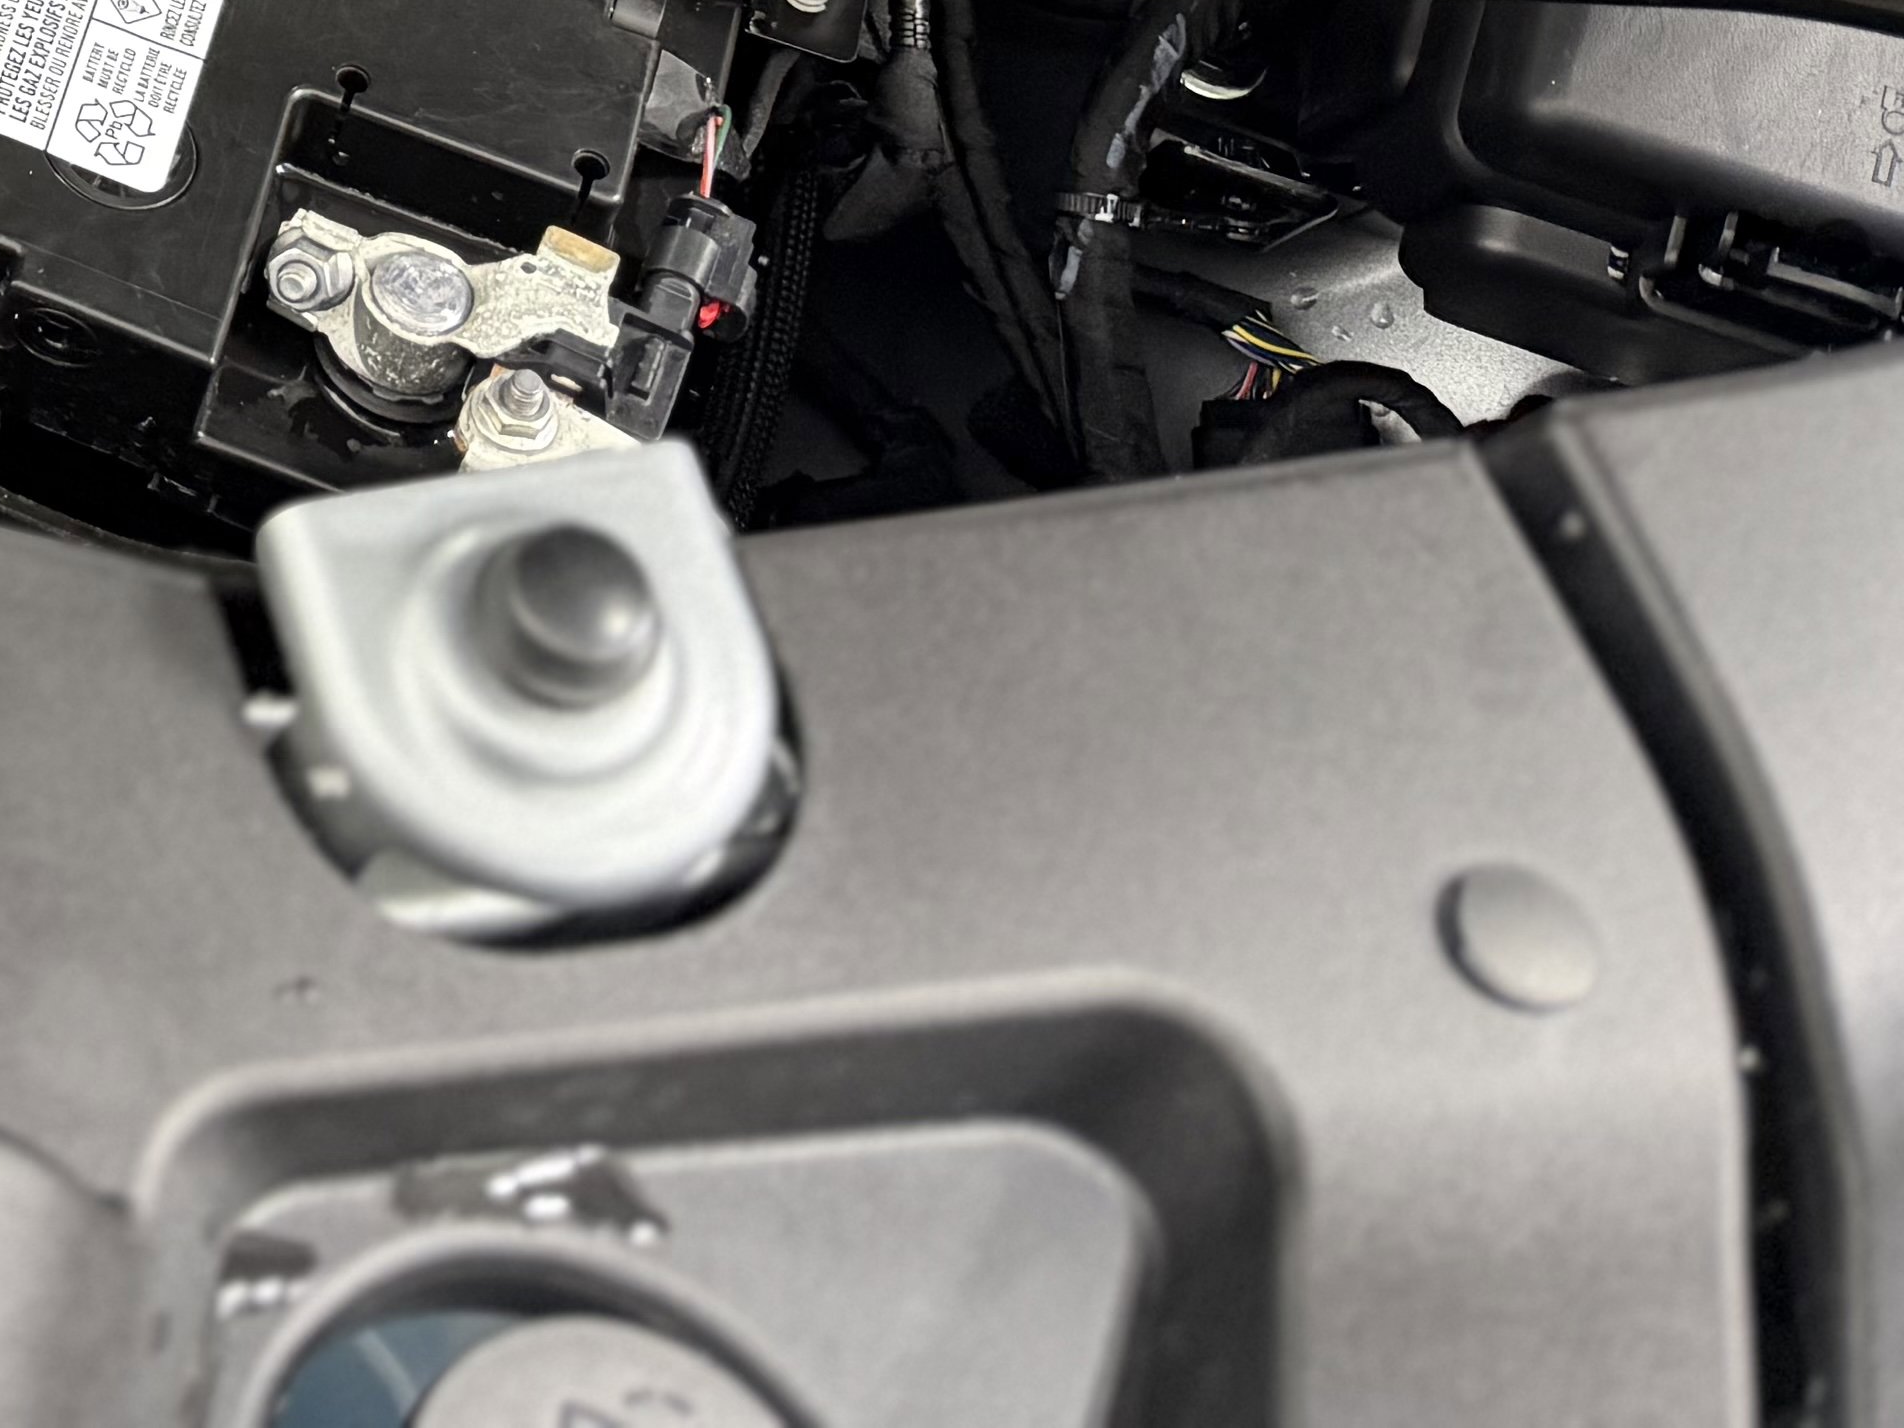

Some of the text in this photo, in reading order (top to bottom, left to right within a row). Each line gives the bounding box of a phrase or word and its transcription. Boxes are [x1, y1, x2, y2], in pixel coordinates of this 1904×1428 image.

[13, 23, 35, 47] LES
[29, 0, 66, 69] EXPLOSIFS
[55, 10, 83, 58] RENDRE
[48, 57, 67, 76] OU
[19, 69, 42, 96] GAZ
[30, 76, 61, 130] BLESSER
[134, 90, 146, 103] LA
[9, 97, 32, 123] LES
[105, 121, 123, 140] Pb
